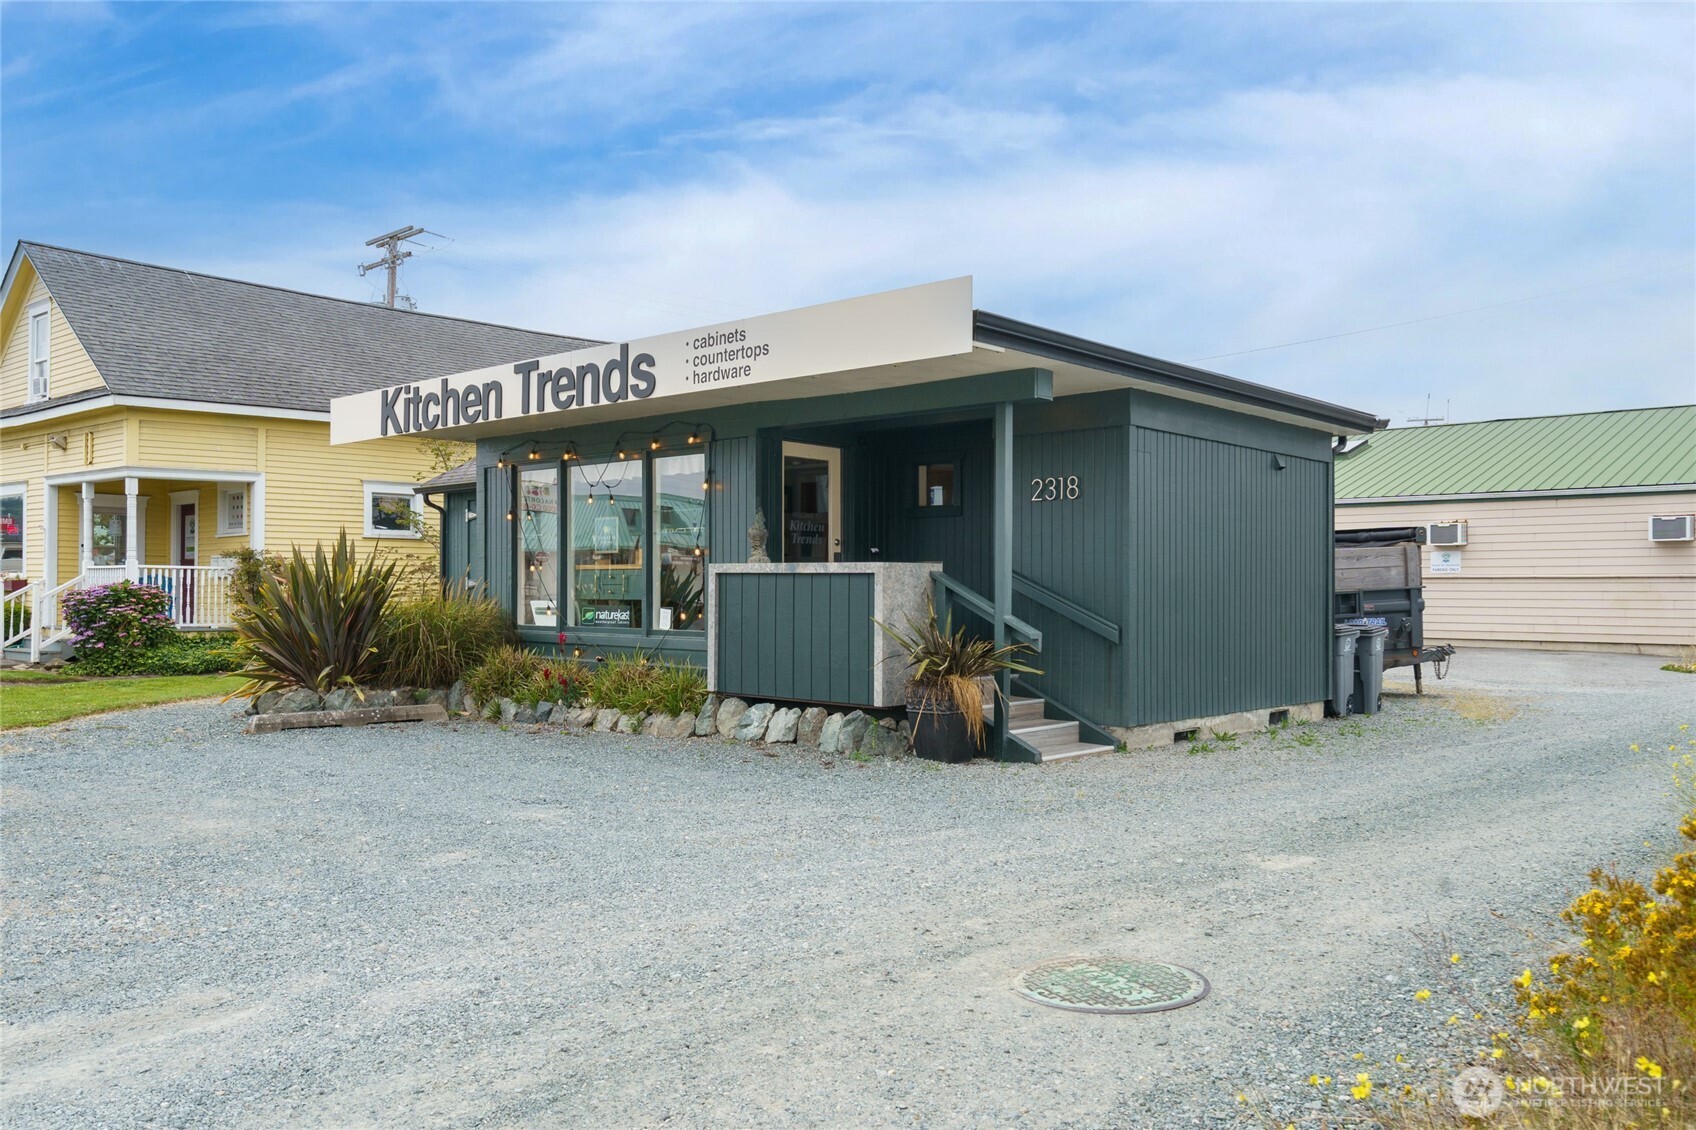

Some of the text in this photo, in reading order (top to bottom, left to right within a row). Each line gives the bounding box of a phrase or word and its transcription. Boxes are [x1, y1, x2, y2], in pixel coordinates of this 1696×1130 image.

[693, 328, 747, 350] cabinets
[692, 343, 770, 367] countertops
[692, 364, 752, 385] hardware
[380, 343, 656, 436] Kitchen Trends
[1031, 475, 1079, 501] 2318
[790, 519, 825, 532] Kitchen
[791, 532, 823, 545] Trends
